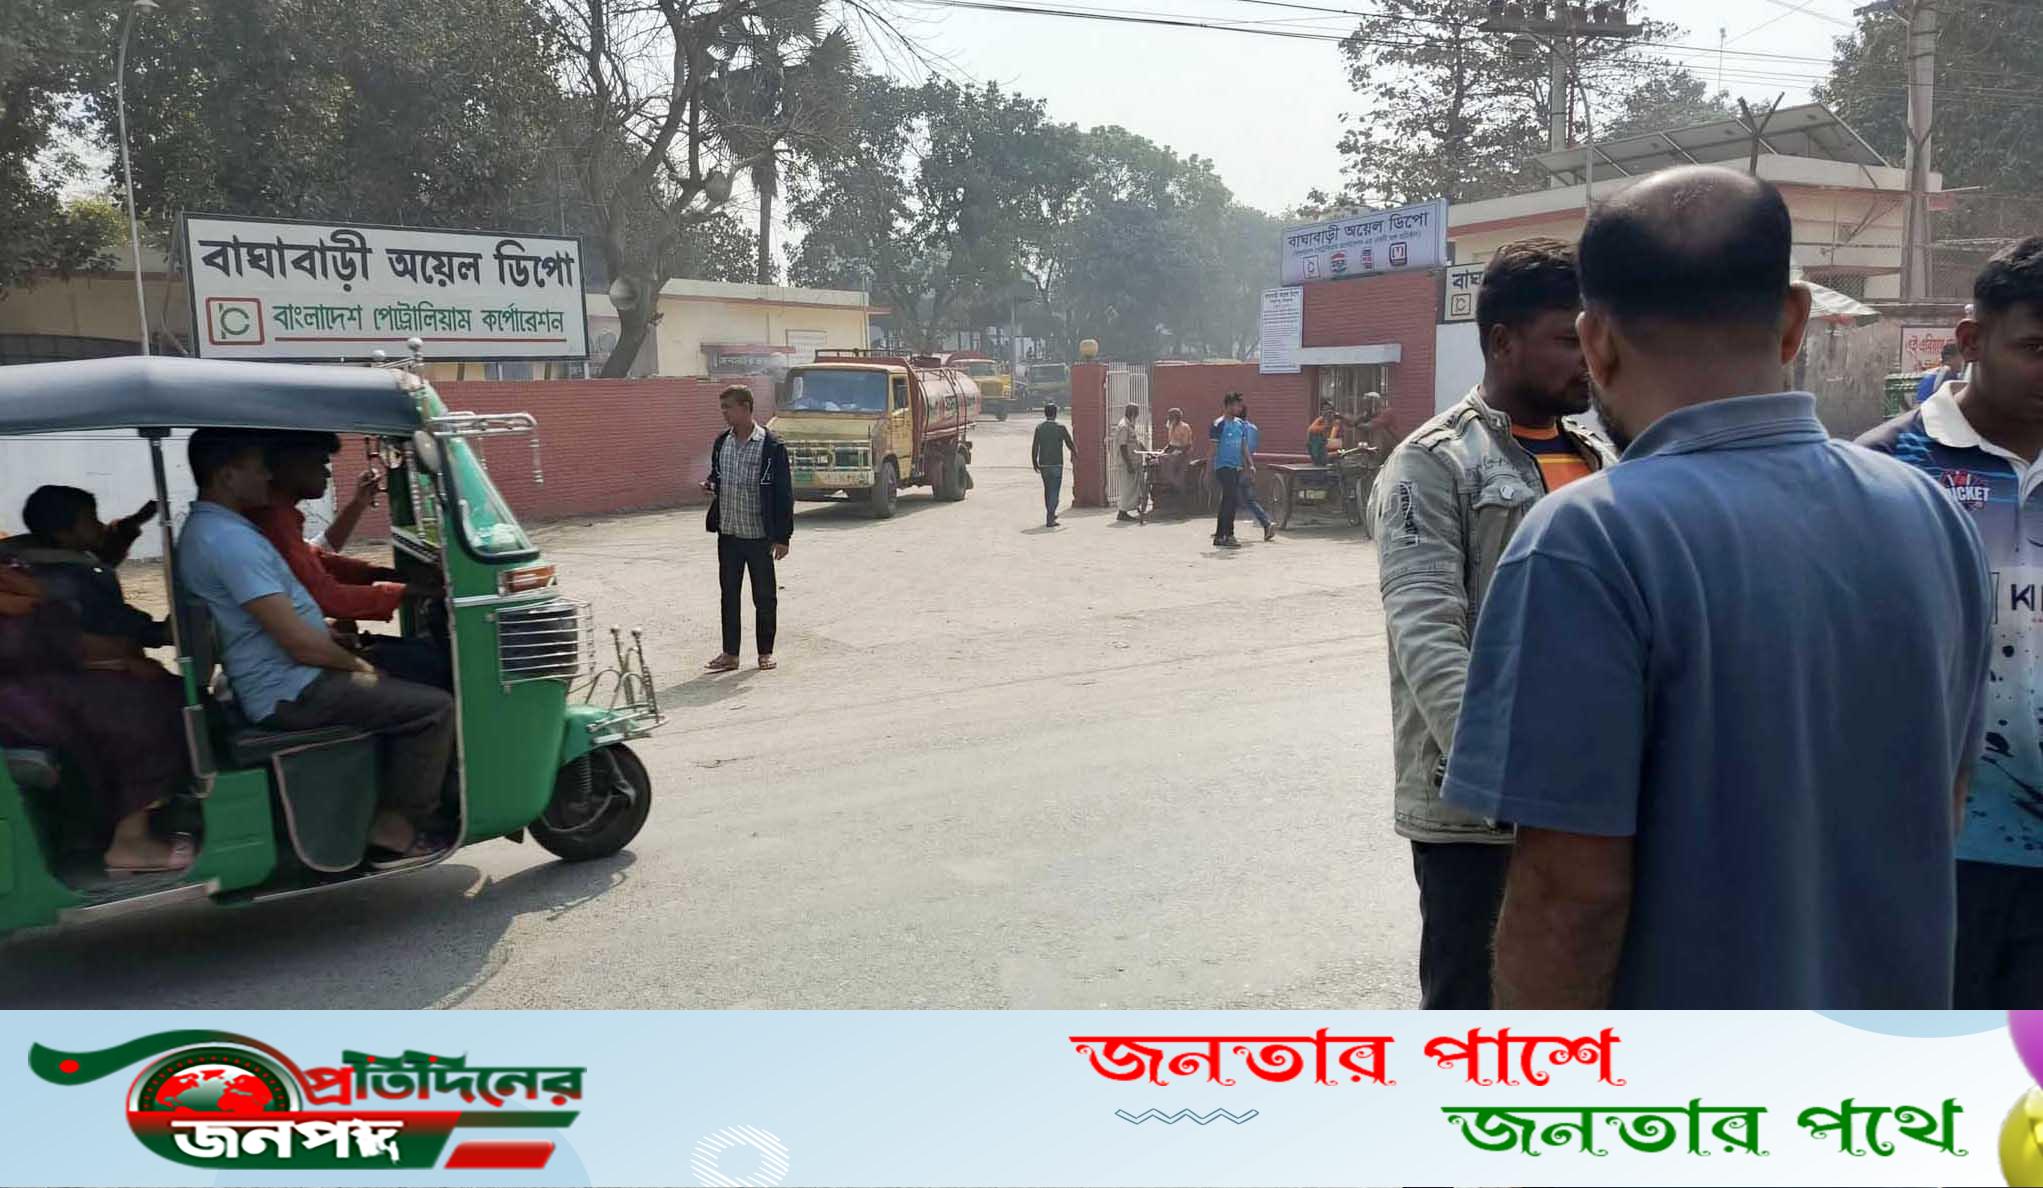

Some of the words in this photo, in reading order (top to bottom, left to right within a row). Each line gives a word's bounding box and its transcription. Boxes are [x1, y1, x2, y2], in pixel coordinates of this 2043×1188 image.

[1287, 224, 1340, 246] বাঘাবাড়ী
[1343, 219, 1384, 237] অয়েল
[1389, 211, 1429, 232] ডিপো
[197, 228, 374, 292] বাঘাবাড়ী
[384, 248, 483, 288] অয়েল
[492, 239, 575, 288] ডিপো
[271, 304, 364, 331] বাংলাদেশ
[373, 300, 473, 332] পেট্রোলিয়াম
[479, 302, 566, 333] কর্পোরেশন
